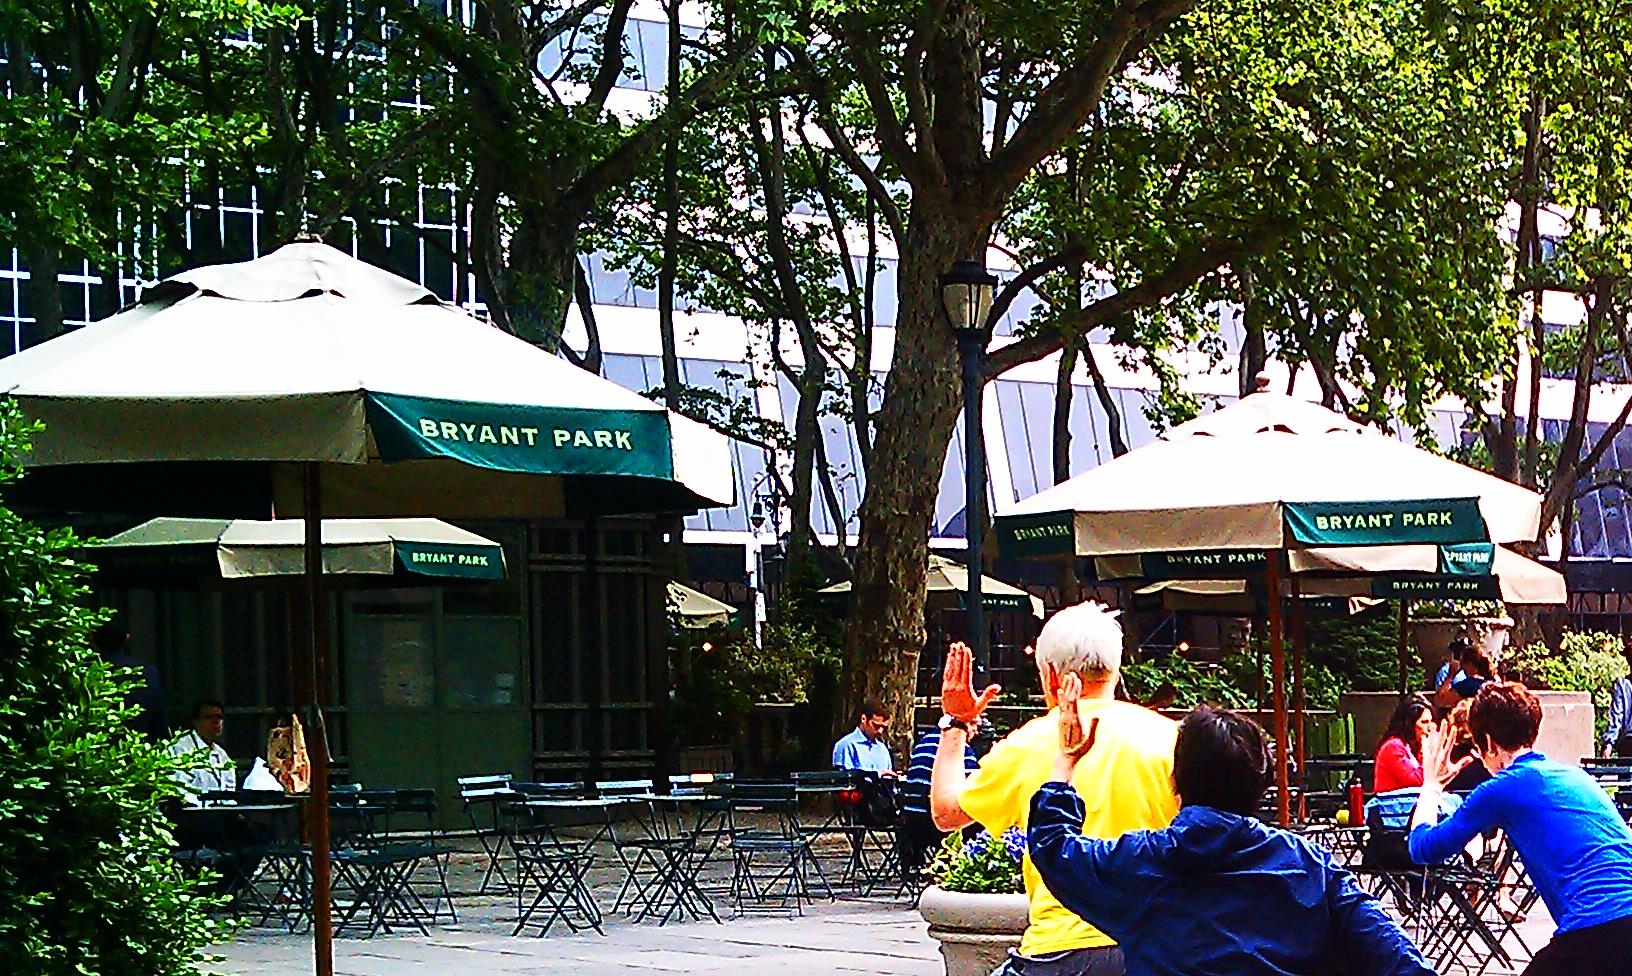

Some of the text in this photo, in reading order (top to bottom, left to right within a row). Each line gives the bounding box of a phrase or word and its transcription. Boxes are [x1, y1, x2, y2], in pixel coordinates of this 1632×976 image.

[419, 418, 633, 450] BRYANT PARK
[1316, 511, 1453, 530] BRYANT PARK
[411, 552, 489, 567] BRYANT PARK
[1166, 552, 1267, 564] BRYANT PARK
[1392, 581, 1479, 590] BRYANT PARK
